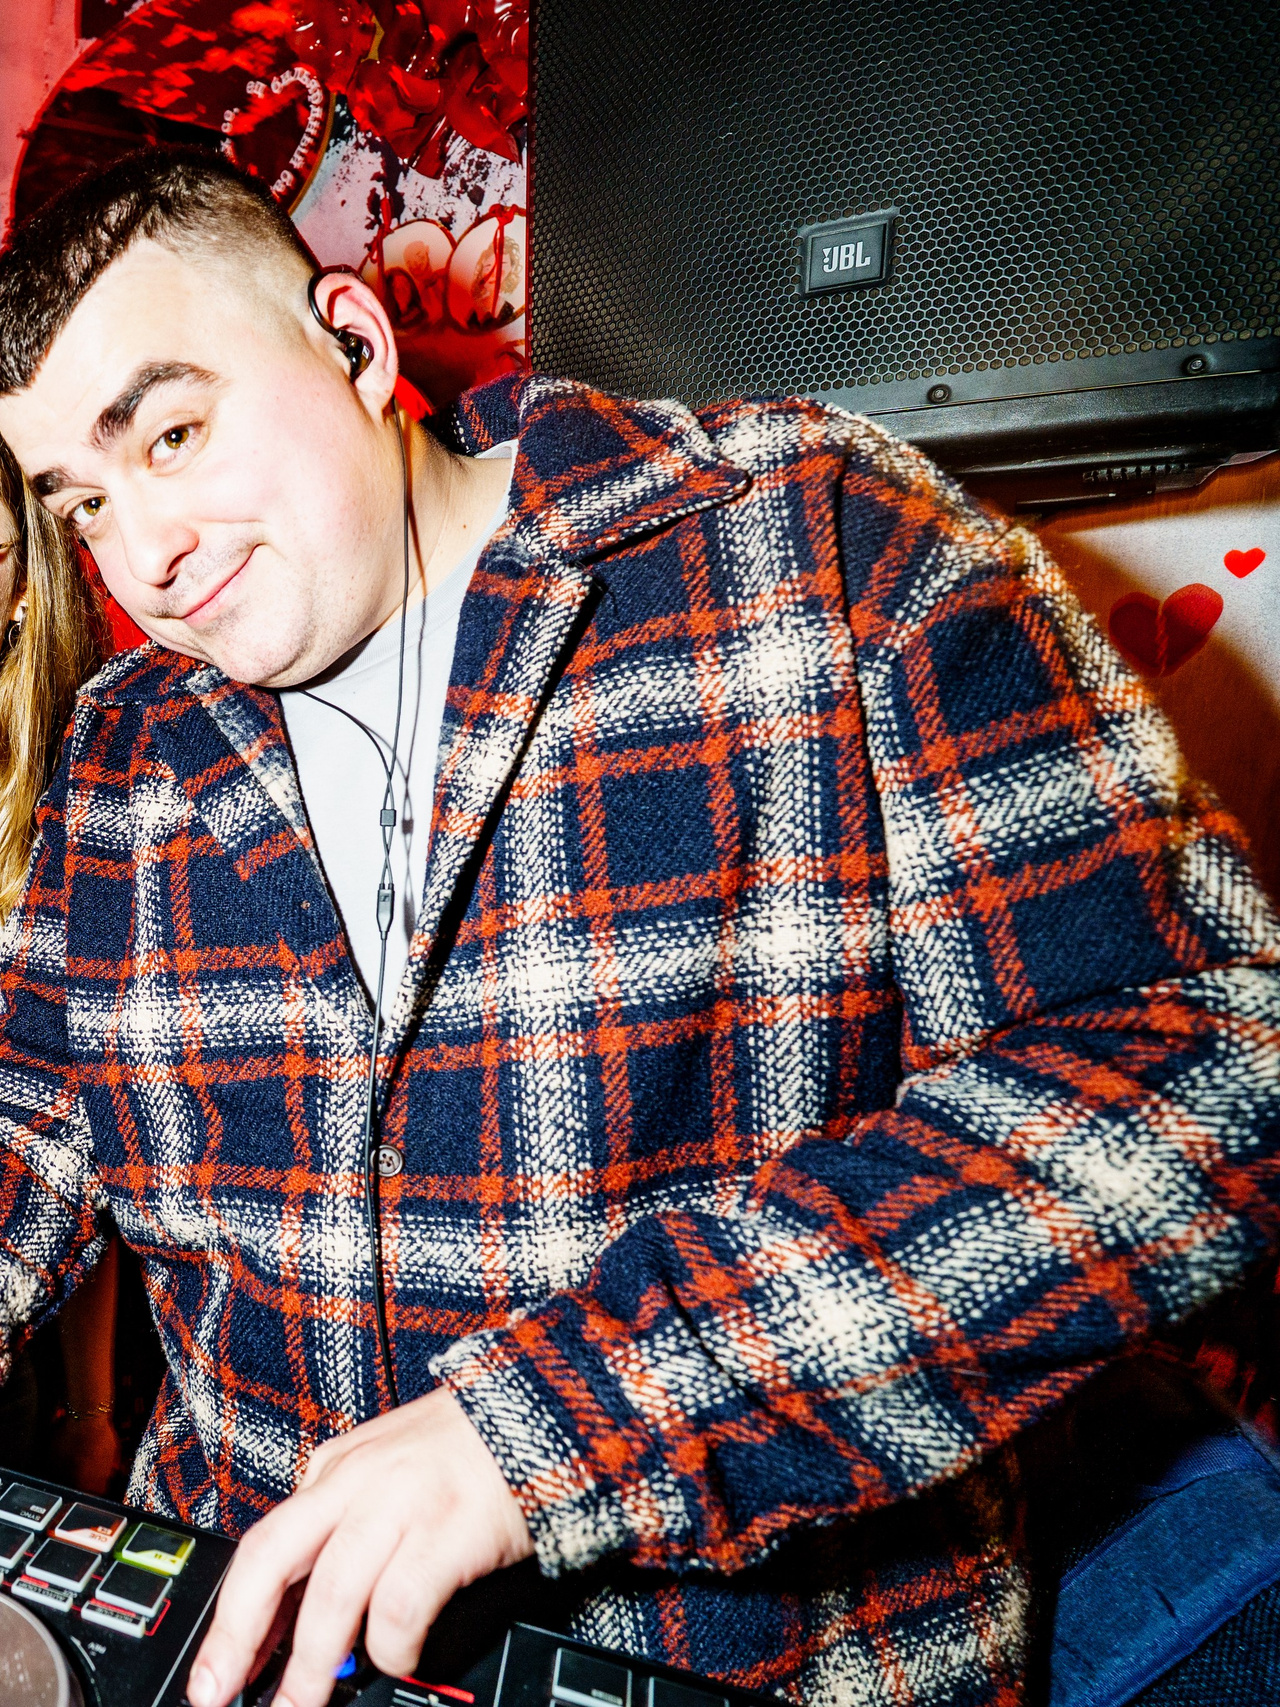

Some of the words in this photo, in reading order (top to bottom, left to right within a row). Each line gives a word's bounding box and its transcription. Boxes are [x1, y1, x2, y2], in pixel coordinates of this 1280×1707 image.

[821, 241, 872, 273] JBL
[19, 1509, 41, 1521] SYNC
[88, 1532, 108, 1543] CUE
